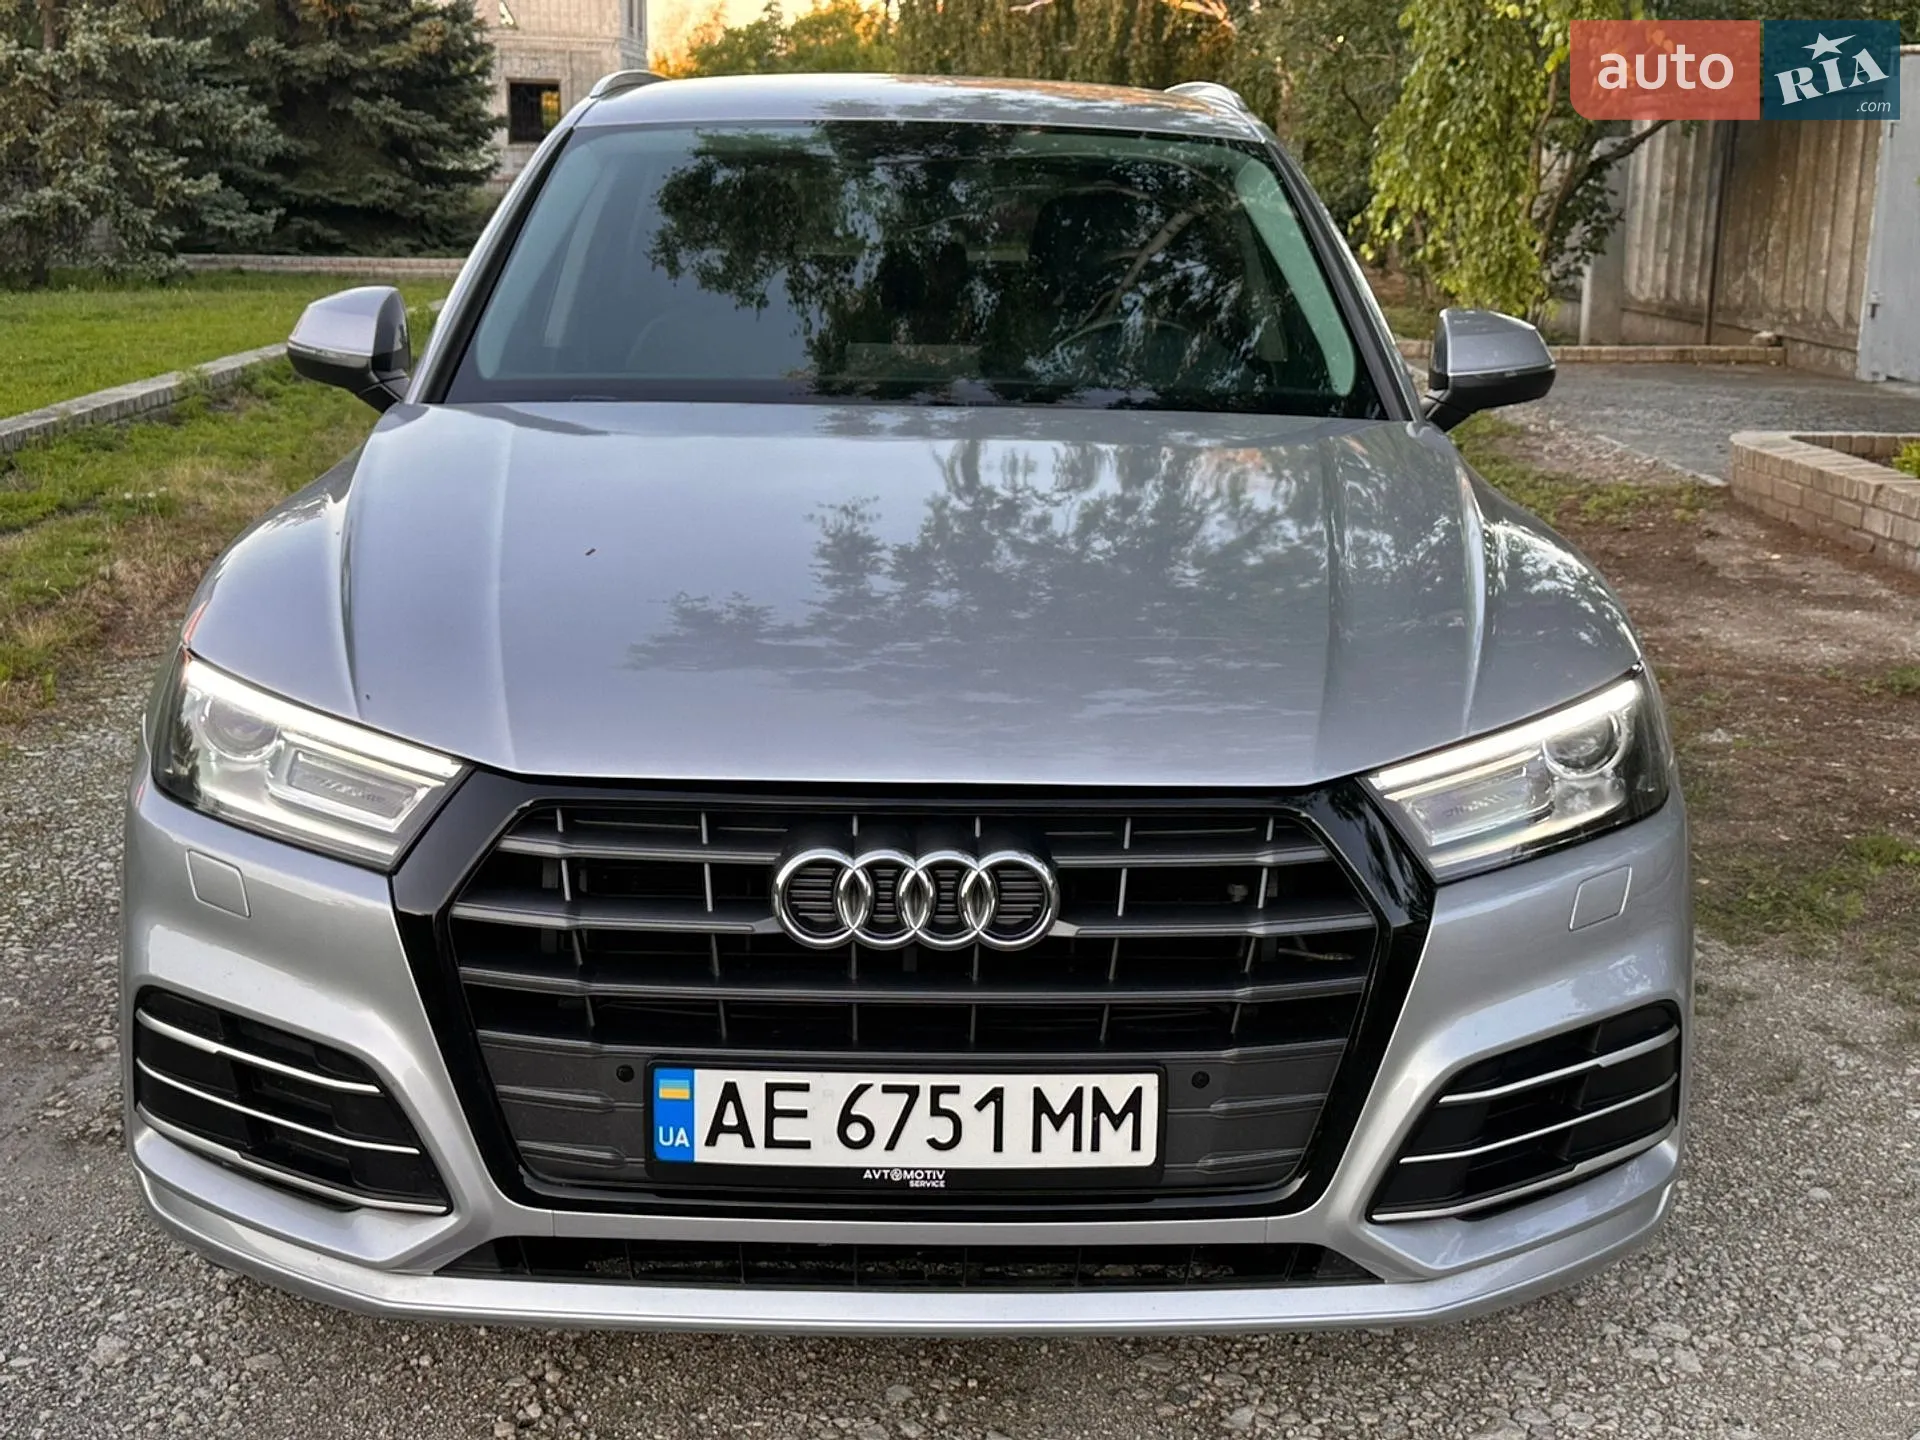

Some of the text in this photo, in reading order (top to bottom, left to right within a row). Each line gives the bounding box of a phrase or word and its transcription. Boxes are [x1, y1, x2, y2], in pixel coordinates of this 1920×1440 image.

[704, 1081, 1143, 1153] AE 6751 MM
[659, 1127, 690, 1148] UA
[909, 1180, 946, 1188] SERVICE
